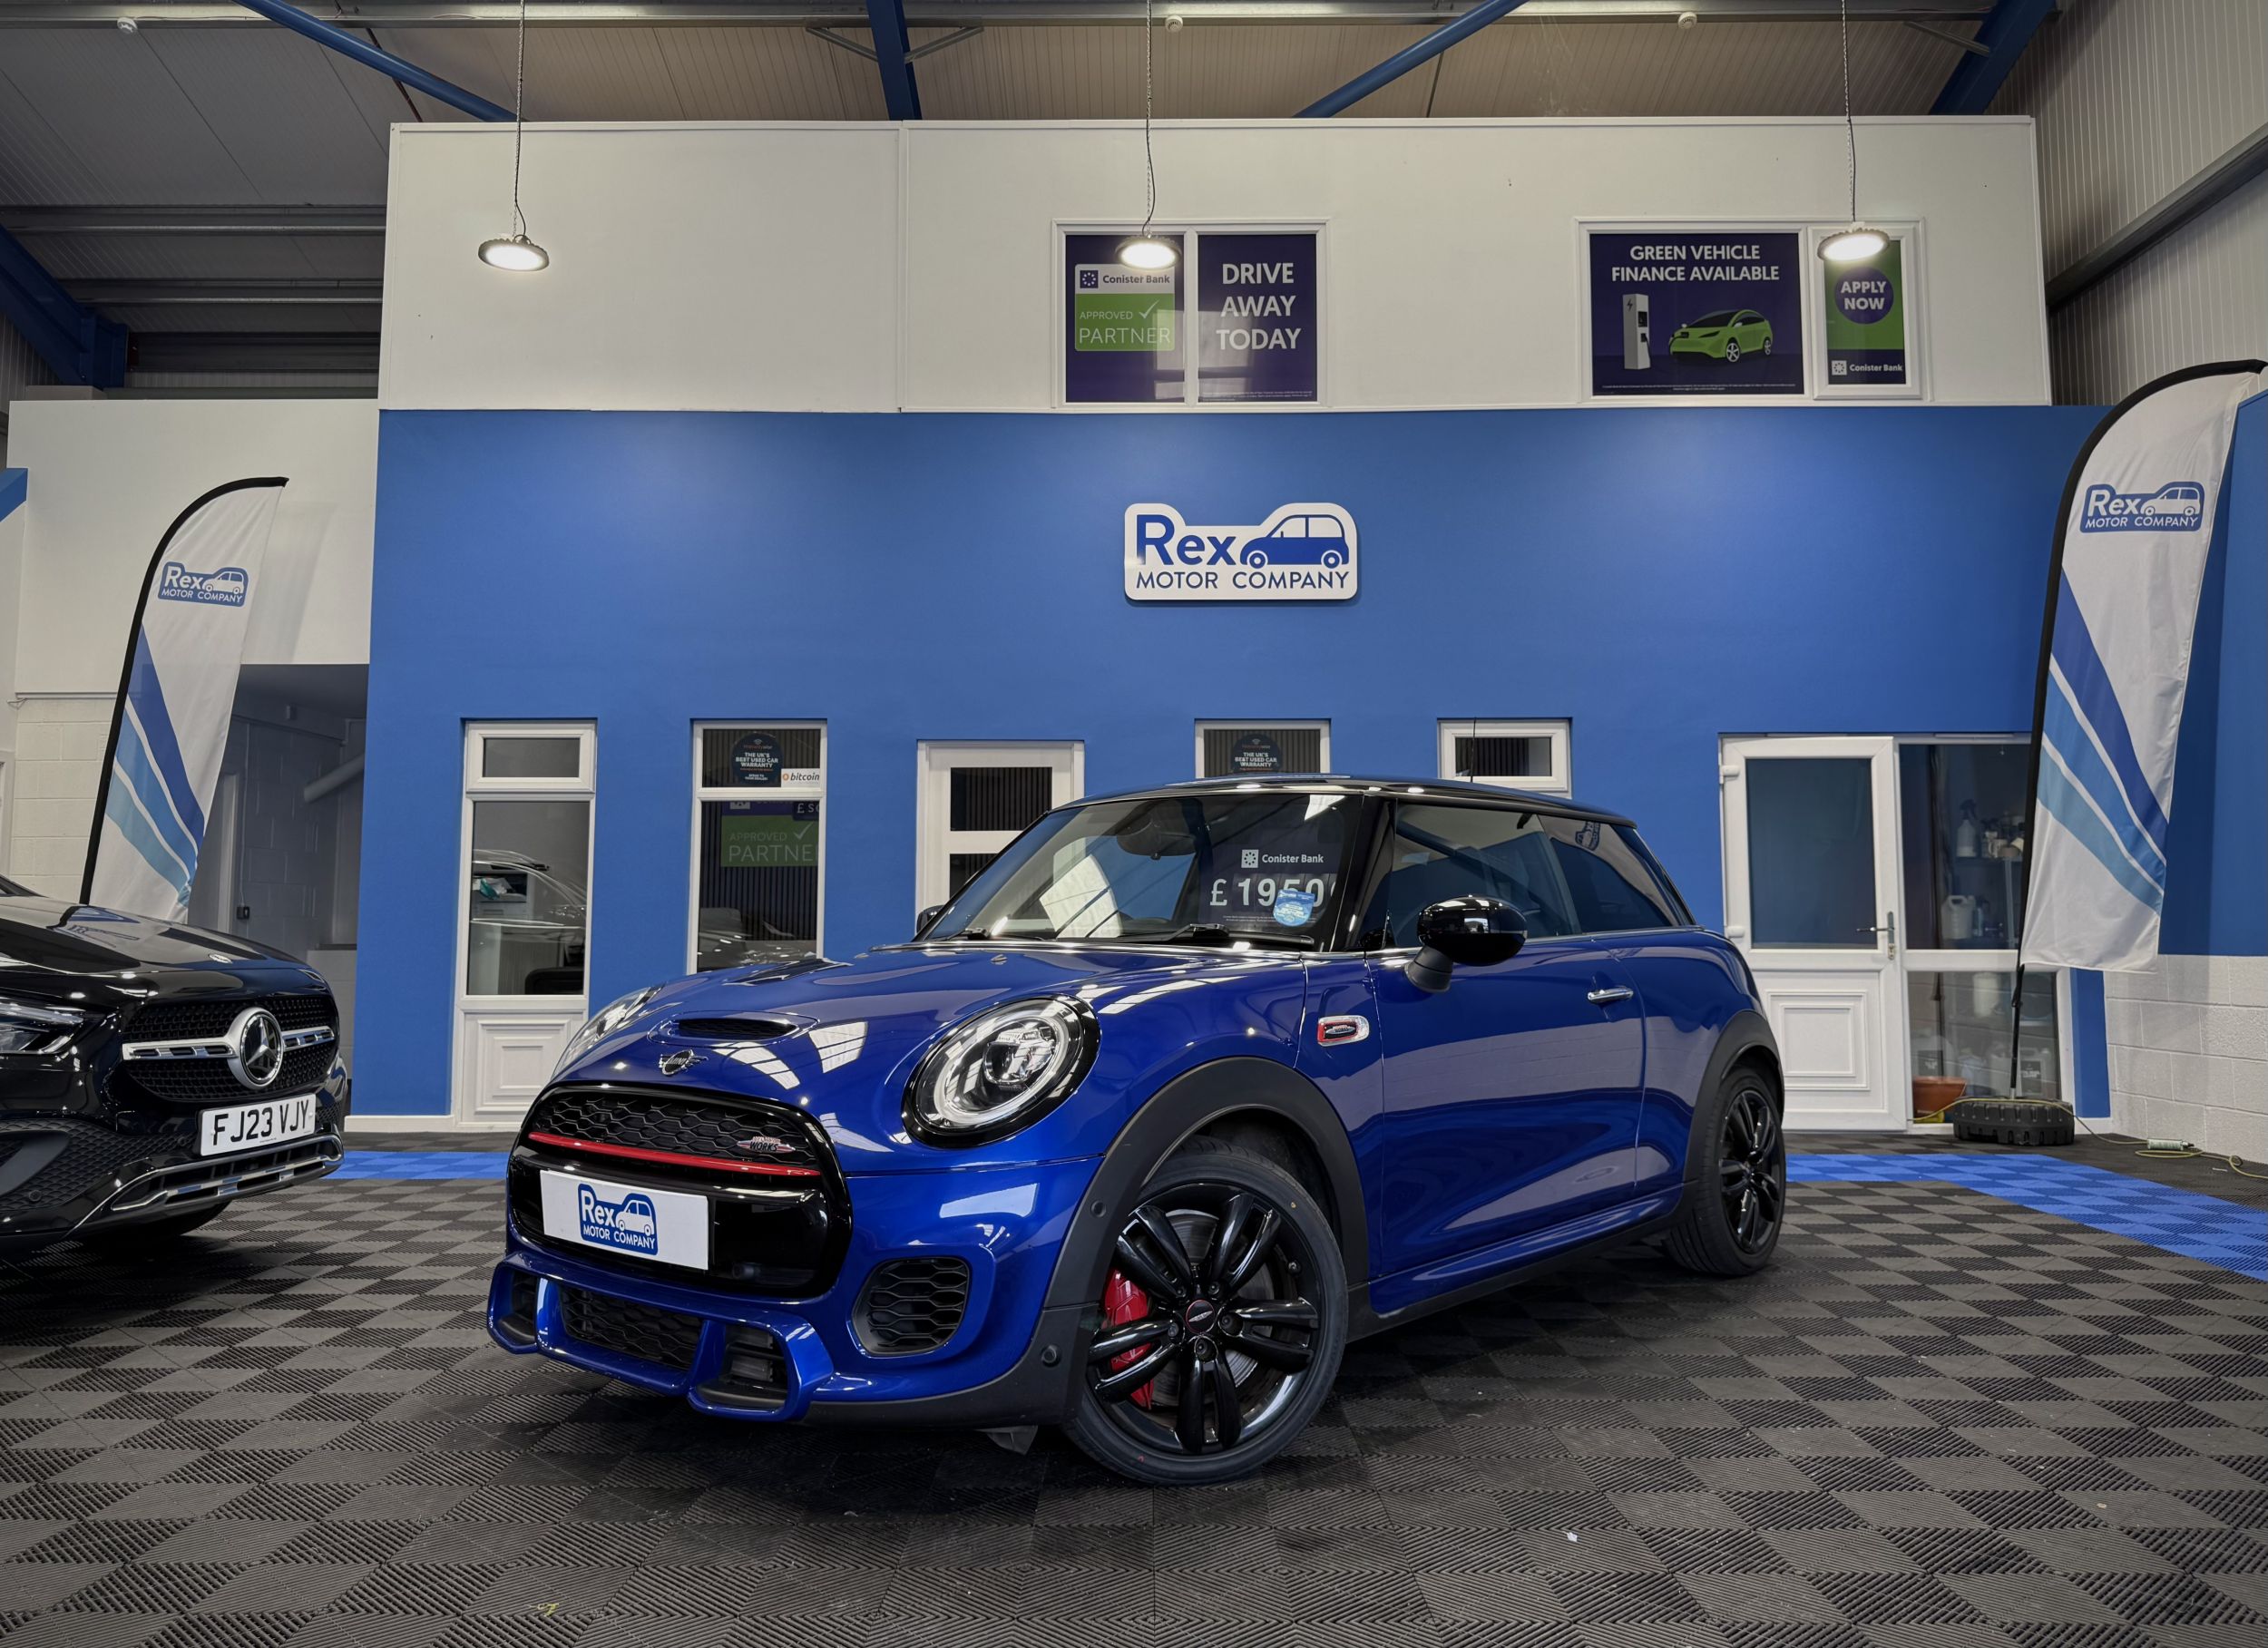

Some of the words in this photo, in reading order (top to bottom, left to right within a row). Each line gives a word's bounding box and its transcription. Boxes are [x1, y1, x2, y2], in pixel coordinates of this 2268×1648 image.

[1629, 245, 1686, 261] GREEN
[1691, 244, 1760, 260] VEHICLE
[1102, 274, 1144, 284] Conister
[1146, 274, 1170, 284] Bank
[1222, 262, 1294, 285] DRIVE
[1611, 266, 1685, 282] FINANCE
[1689, 265, 1779, 281] AVAILABLE
[1840, 280, 1887, 294] APPLY
[1220, 295, 1296, 317] AWAY
[1843, 297, 1885, 310] NOW
[1080, 310, 1133, 320] APPROVED
[1079, 327, 1170, 345] PARTNER
[1216, 327, 1302, 350] TODAY
[1849, 364, 1882, 372] Conister
[1882, 364, 1903, 372] Bank
[2087, 489, 2142, 517] Rex
[2085, 516, 2128, 529] MOTOR
[2134, 516, 2198, 528] COMPANY
[1136, 513, 1237, 566] Rex
[164, 565, 204, 590] Rex
[1136, 570, 1218, 590] MOTOR
[1232, 570, 1350, 590] COMPANY
[161, 588, 194, 599] MOTOR
[197, 590, 243, 603] COMPANY
[790, 772, 820, 781] bitcoin
[729, 831, 787, 842] APPROVED
[728, 844, 818, 863] PARTNE
[1261, 853, 1299, 863] Conister
[1300, 853, 1325, 863] Bank
[212, 1107, 273, 1146] FJ23
[279, 1099, 309, 1134] VJY
[749, 1141, 778, 1152] WORKS
[581, 1189, 615, 1228] Rex
[582, 1224, 611, 1241] MOTOR
[613, 1231, 655, 1250] COMPANY
